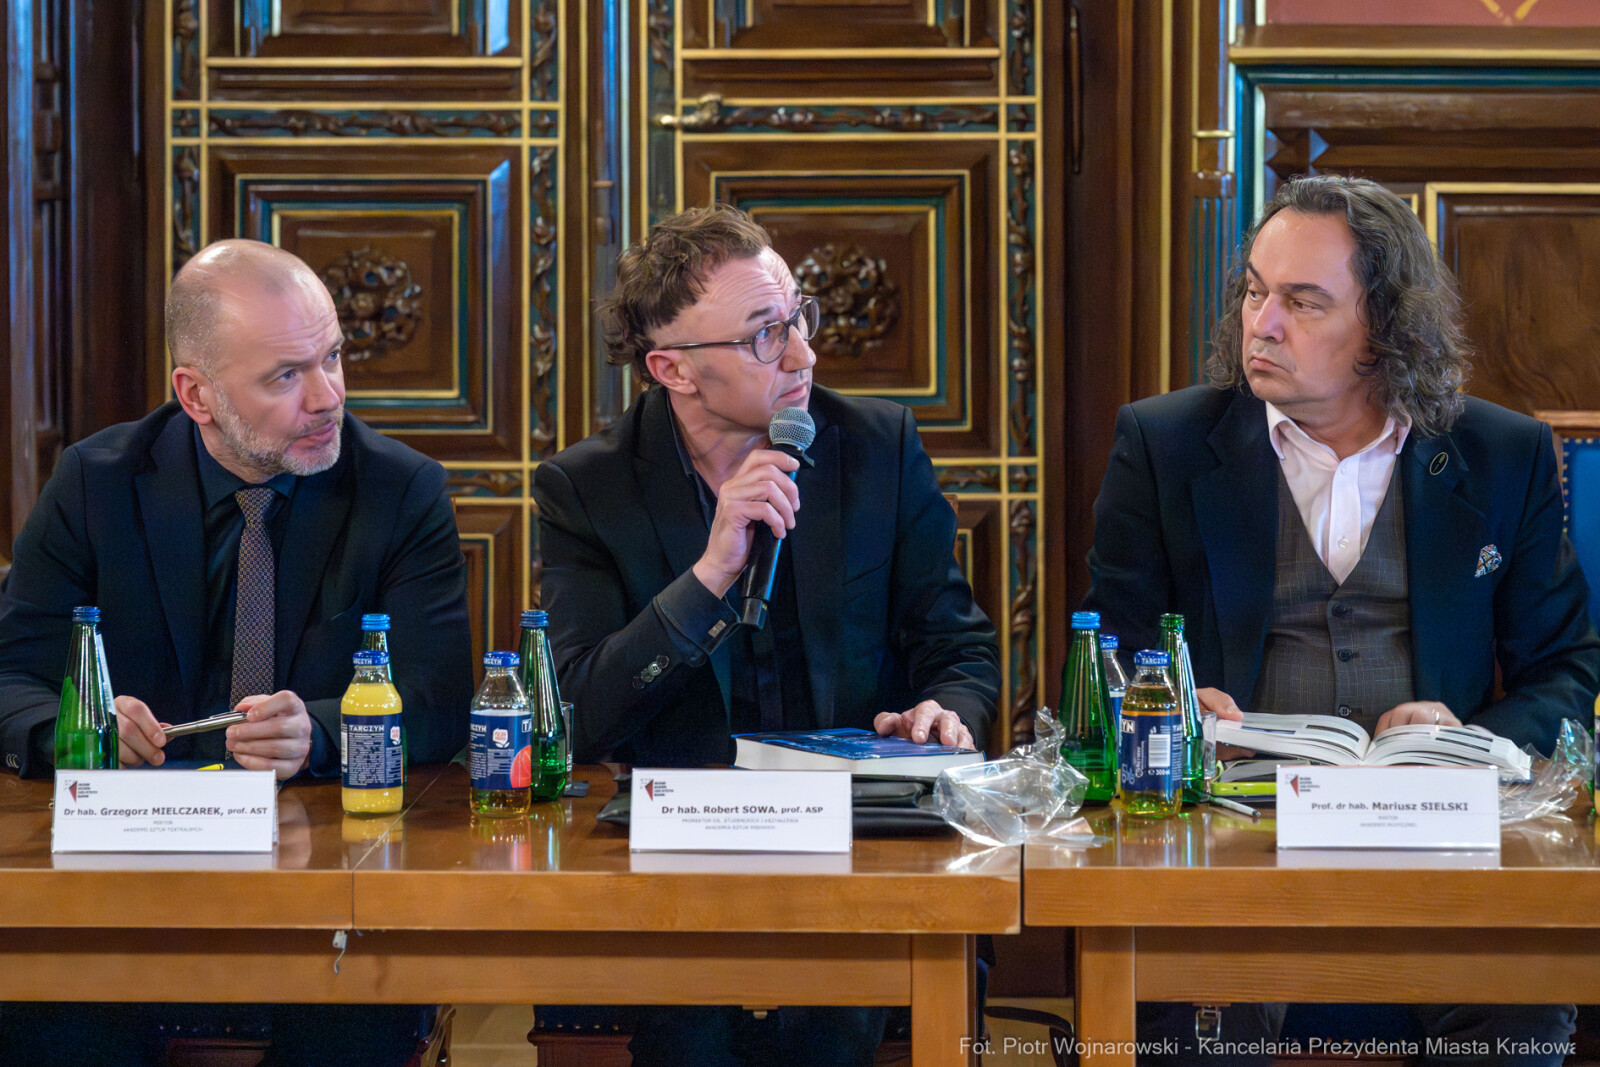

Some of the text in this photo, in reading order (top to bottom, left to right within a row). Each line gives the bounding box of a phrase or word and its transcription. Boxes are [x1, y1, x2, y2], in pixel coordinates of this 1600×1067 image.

[349, 724, 385, 732] TARCZYN
[661, 806, 674, 814] Dr
[677, 806, 700, 814] hab.
[703, 806, 739, 814] Robert
[781, 806, 802, 815] prof.
[805, 806, 824, 814] ASP
[1311, 802, 1468, 811] Prof. dr hab. Mariusz SIELSKI
[64, 807, 268, 817] Dr hab. Grzegorz MIELCZAREK, prof. AST
